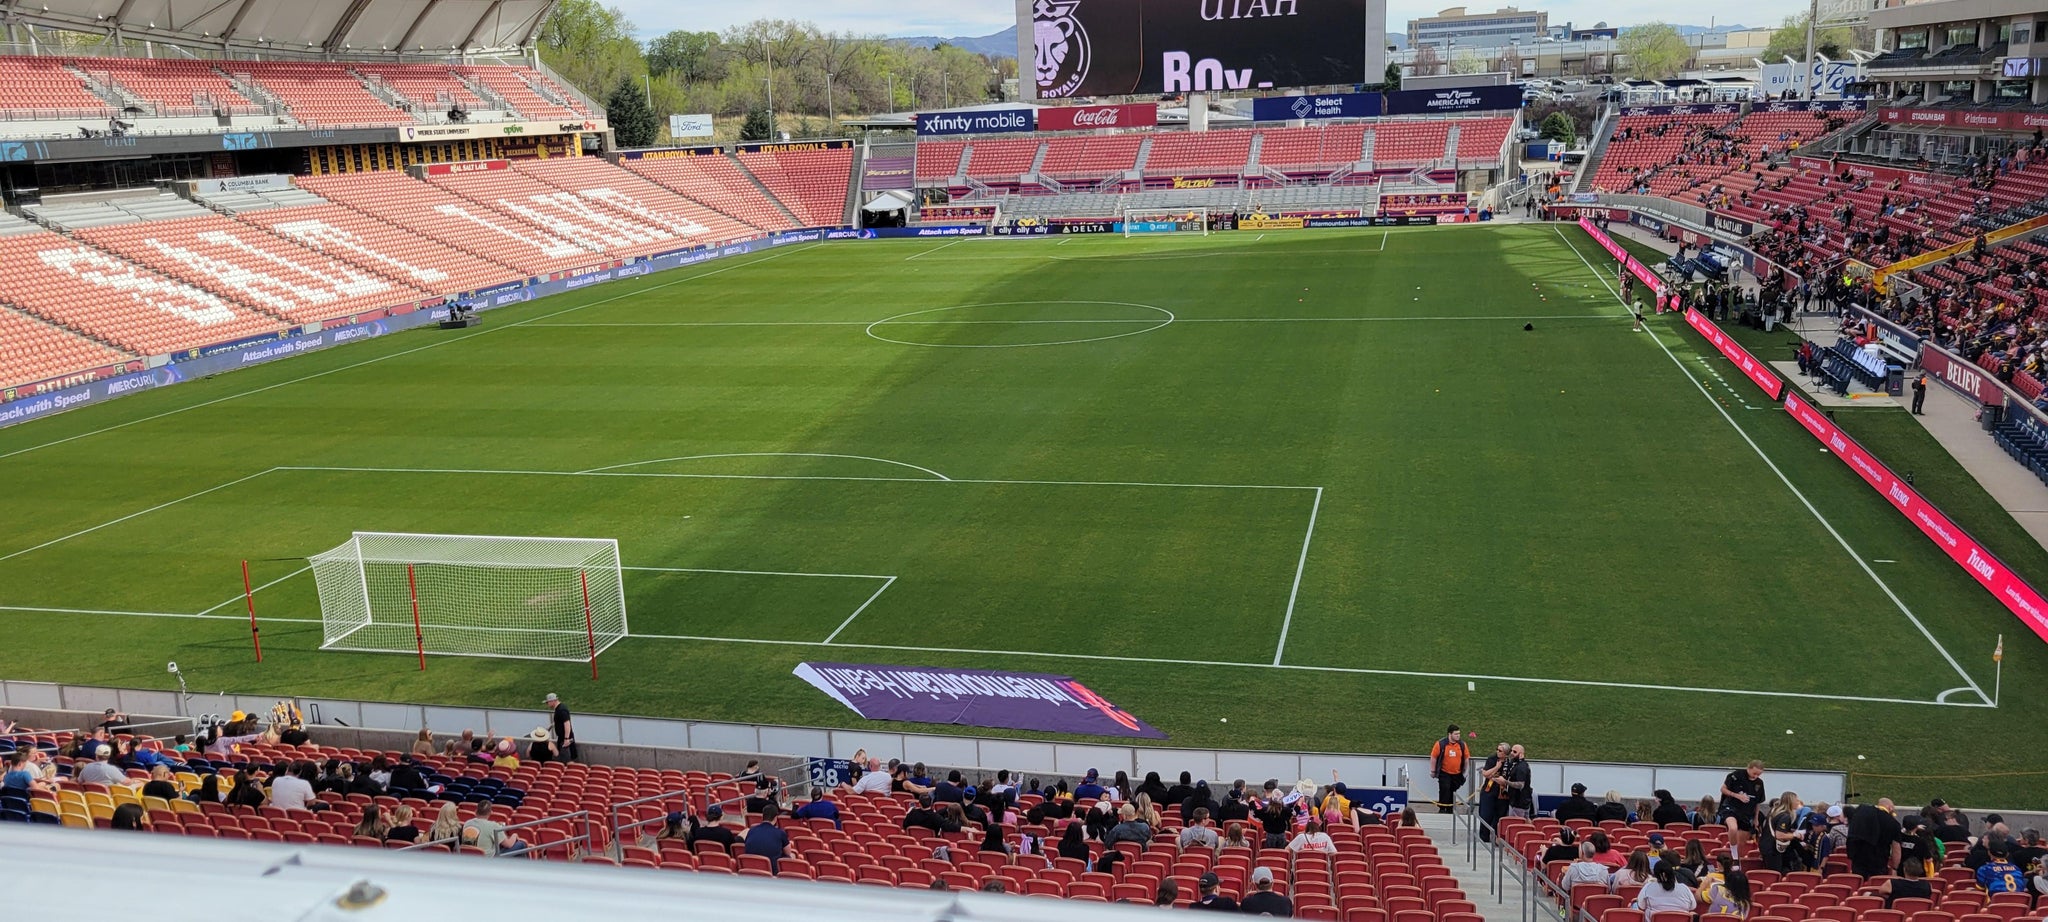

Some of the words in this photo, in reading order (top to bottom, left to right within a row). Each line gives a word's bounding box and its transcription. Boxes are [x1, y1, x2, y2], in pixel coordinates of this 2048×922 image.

[1042, 73, 1080, 98] ROYALS
[1315, 97, 1343, 107] Select
[1427, 99, 1459, 107] AMERICA
[1459, 97, 1481, 105] FIRST
[1808, 102, 1825, 111] Ford
[1840, 101, 1857, 111] Ford
[1315, 106, 1341, 115] Health
[1628, 107, 1650, 117] Ford
[1671, 105, 1693, 115] Ford
[1712, 104, 1731, 114] Ford
[1769, 103, 1790, 112] Ford
[1073, 108, 1120, 126] Coca-Cola
[1912, 112, 1933, 121] STADIUM
[1933, 113, 1945, 121] BAR
[560, 123, 584, 133] KeyBank
[680, 121, 703, 132] Ford
[924, 116, 972, 133] xfinity
[975, 114, 1025, 129] mobile
[504, 124, 524, 134] aptive
[760, 144, 787, 153] UTAH
[788, 142, 828, 152] ROYALS
[643, 151, 662, 160] UTAH
[663, 150, 695, 159] ROYALS
[918, 228, 942, 236] Attack
[959, 227, 983, 236] Speed
[998, 226, 1012, 235] ally
[1016, 226, 1030, 235] ally
[1035, 226, 1048, 234] ally
[1073, 224, 1105, 232] DELTA
[798, 233, 819, 243] Speed
[595, 271, 611, 283] Speed
[242, 349, 274, 363] Attack
[274, 342, 294, 355] with
[295, 336, 322, 351] Speed
[1947, 361, 1982, 397] BELIEVE
[25, 399, 52, 415] with
[54, 388, 90, 408] Speed
[1889, 481, 1909, 507] TYLENOL
[1967, 548, 1995, 581] TYLENOL
[816, 667, 914, 699] Health
[897, 671, 1088, 709] Intermountain
[812, 767, 839, 787] 28
[2004, 874, 2017, 892] 8
